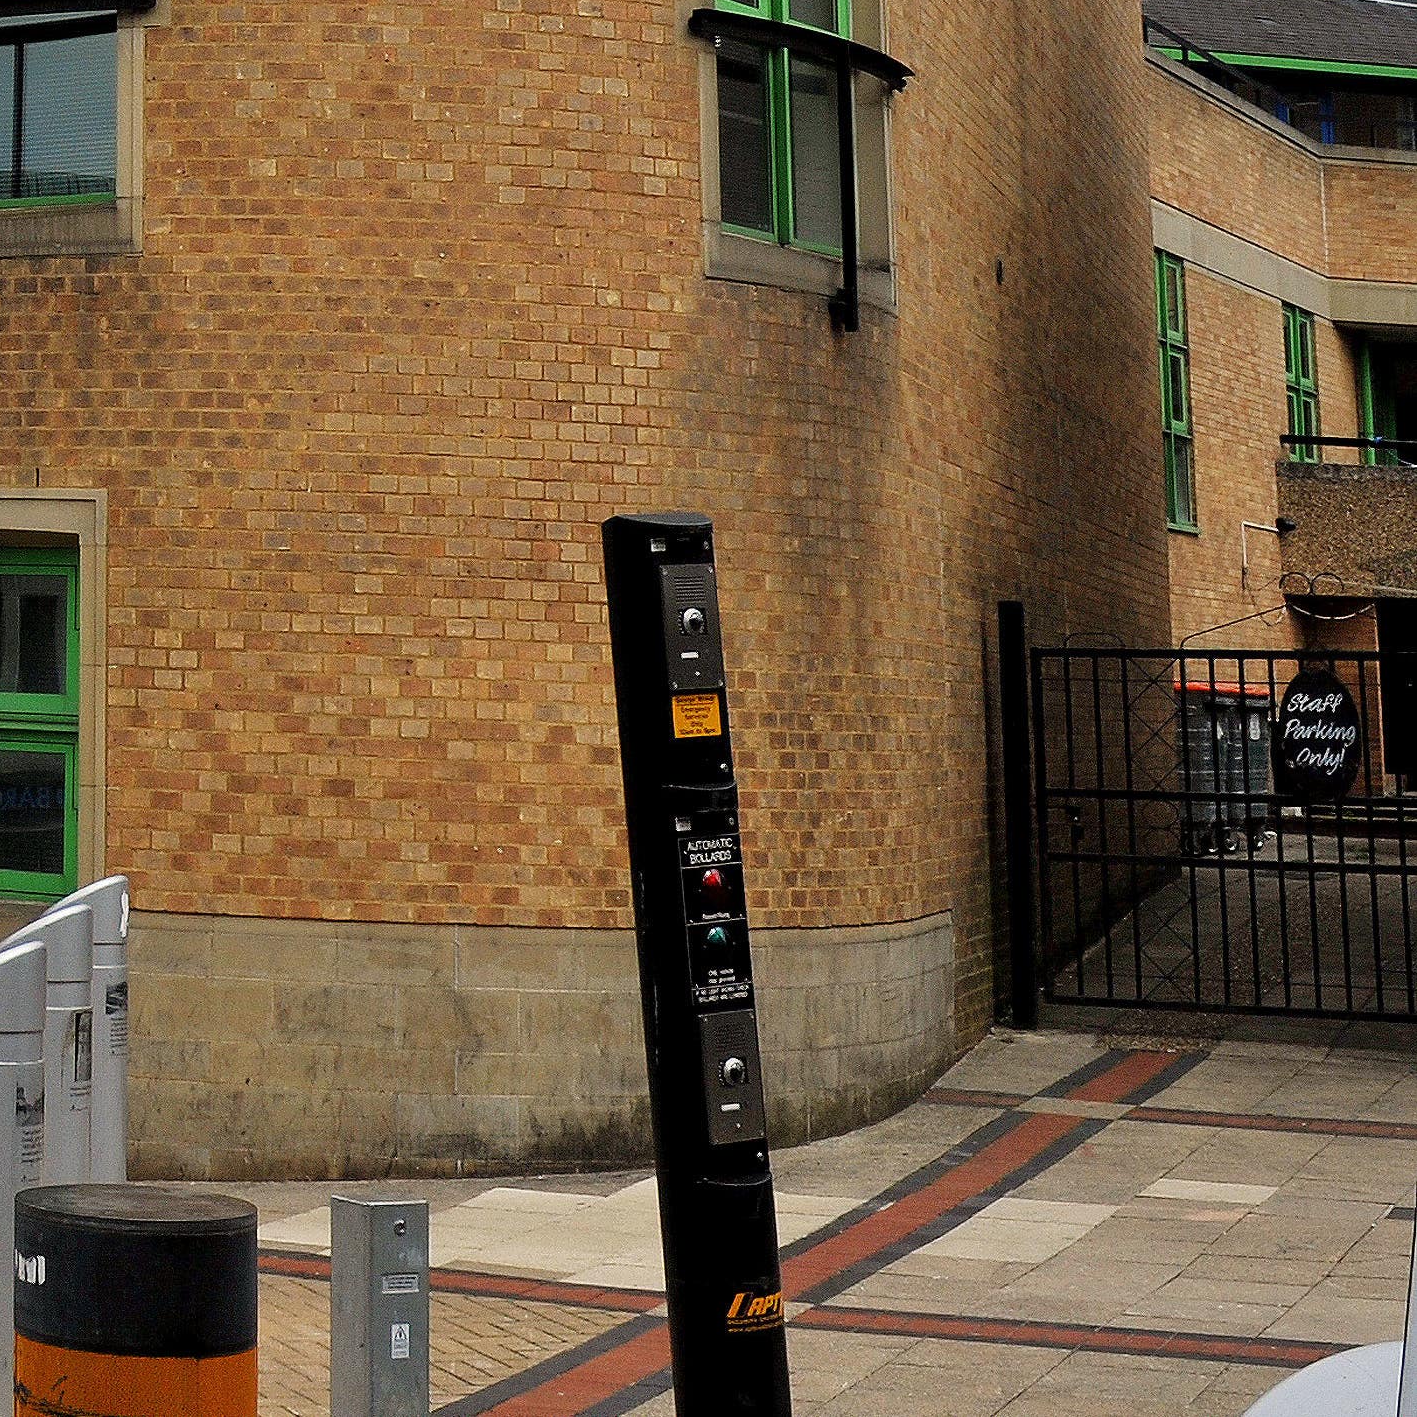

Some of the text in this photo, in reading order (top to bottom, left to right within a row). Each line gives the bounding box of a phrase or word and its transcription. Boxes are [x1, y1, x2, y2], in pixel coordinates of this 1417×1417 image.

[1287, 693, 1344, 714] Staff
[1283, 718, 1357, 748] Parking
[1296, 747, 1346, 776] Only!
[687, 837, 733, 852] AUTOMATIC
[689, 850, 733, 865] BOLLARDS
